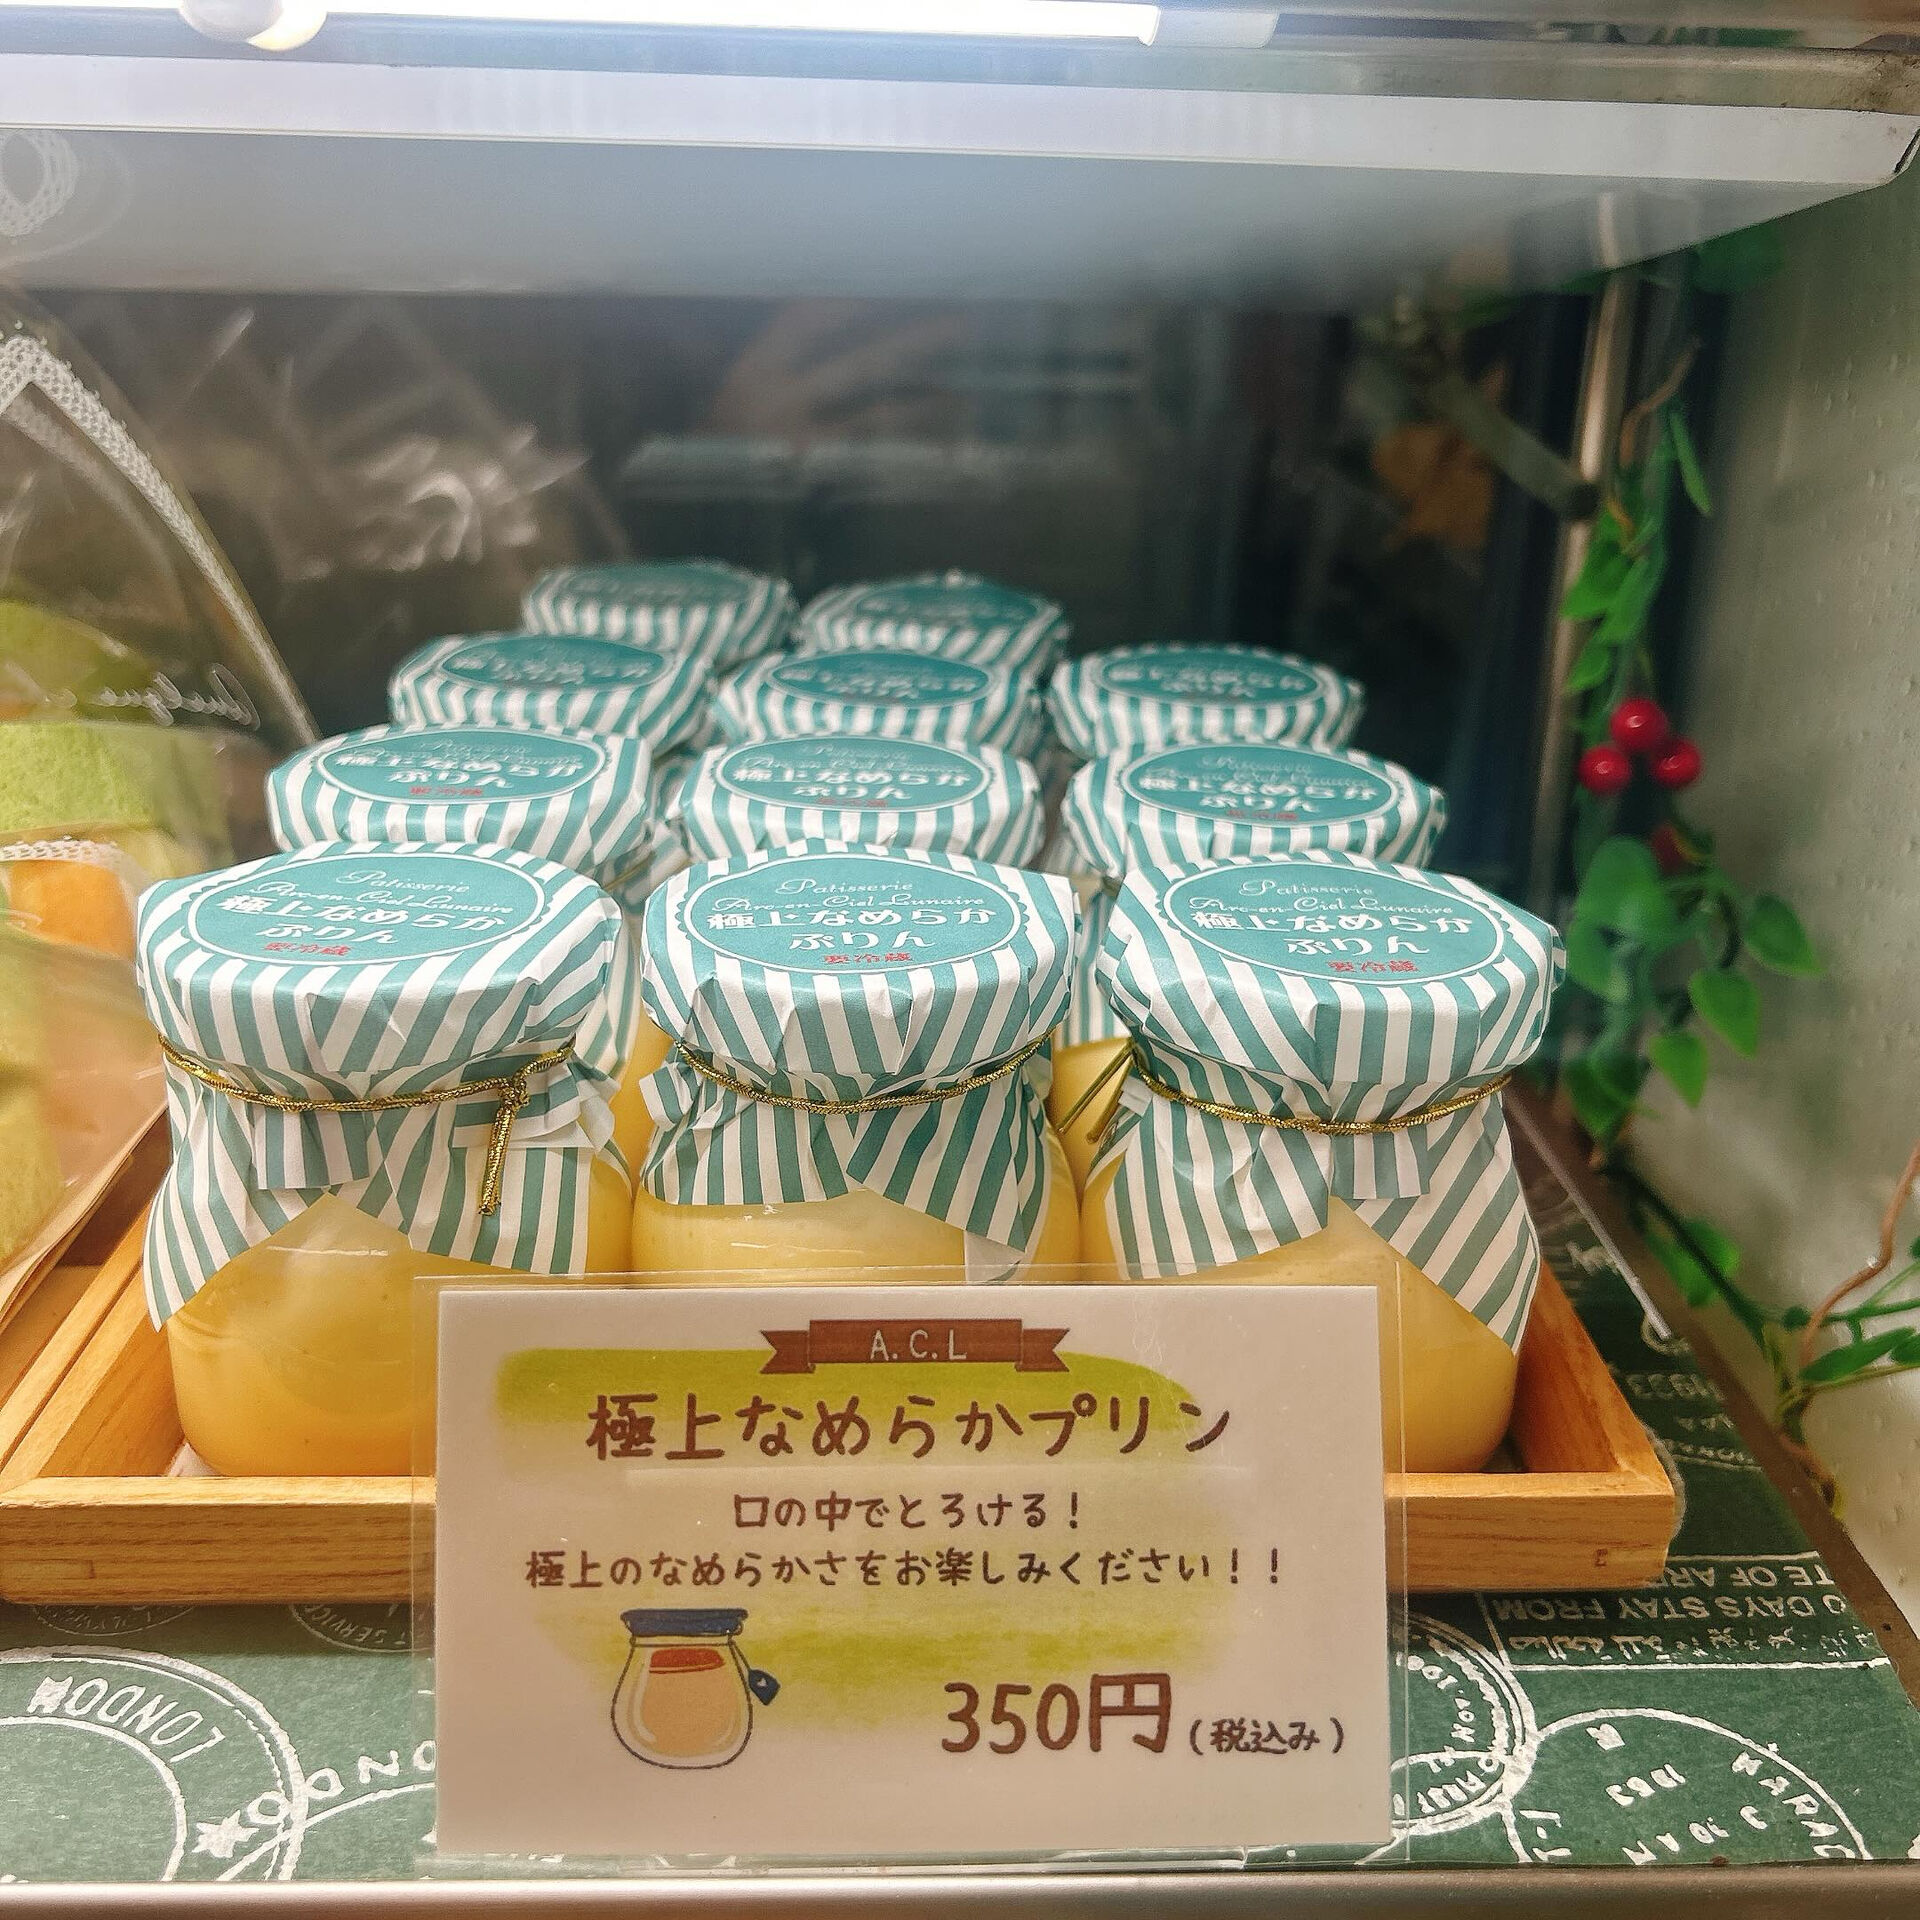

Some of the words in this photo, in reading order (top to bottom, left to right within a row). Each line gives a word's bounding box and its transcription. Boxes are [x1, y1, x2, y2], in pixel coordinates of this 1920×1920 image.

[216, 893, 506, 931] 極上なめらか
[706, 908, 998, 930] 極上なめらか
[1190, 911, 1474, 935] 極上なめらか
[255, 922, 399, 945] ぷりん
[788, 930, 937, 950] ぷりん
[1283, 936, 1431, 957] ぷりん
[869, 1328, 968, 1361] A.C.L
[585, 1392, 1230, 1462] 極上なめらかプリン
[733, 1490, 1081, 1534] 口の中でとろける！
[525, 1546, 1283, 1590] 極上のなめらかさをお楽しみください！！
[1731, 1565, 1778, 1588] OF
[1498, 1596, 1609, 1622] FROM
[1618, 1596, 1708, 1621] STAY
[1715, 1595, 1816, 1619] DAYS
[940, 1672, 1173, 1755] 350円
[1188, 1716, 1346, 1756] (税込み)
